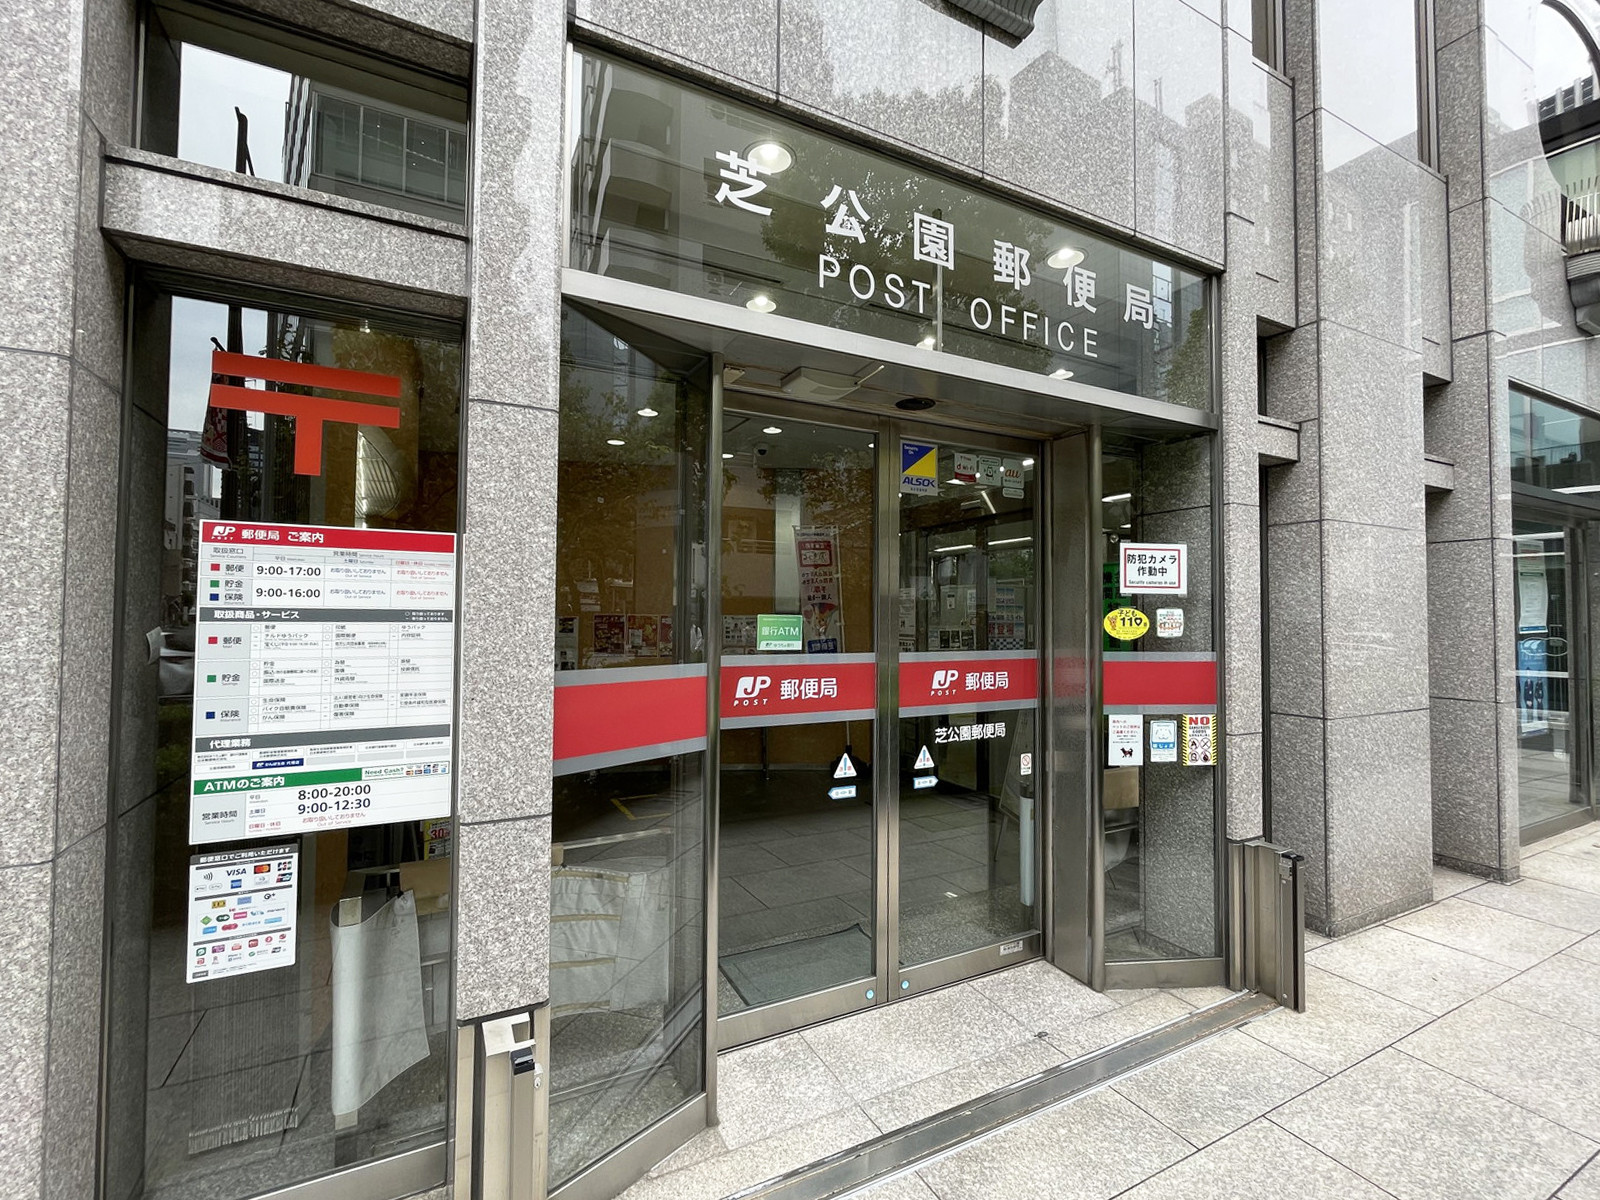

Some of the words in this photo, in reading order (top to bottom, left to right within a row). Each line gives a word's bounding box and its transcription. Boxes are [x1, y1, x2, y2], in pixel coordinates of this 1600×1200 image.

[714, 149, 1154, 329] 芝公園郵便局
[818, 254, 931, 314] POST
[970, 297, 1098, 358] OFFICE
[902, 476, 935, 487] ALSOK
[241, 529, 280, 541] 郵便局
[288, 531, 324, 543] ご案内
[1127, 554, 1177, 564] 防犯カメラ
[225, 564, 244, 573] 郵便
[256, 565, 321, 576] 9:00-17:00
[1137, 566, 1168, 577] 作動中
[224, 580, 243, 588] 貯金
[224, 593, 243, 601] 保険
[255, 588, 321, 598] 9:00-16:00
[214, 610, 300, 619] 取扱商品・サービス
[1118, 609, 1137, 617] 子ども
[761, 626, 799, 636] 銀行ATM
[223, 636, 242, 645] 郵便
[222, 674, 240, 682] 貯金
[931, 669, 959, 689] JP
[965, 671, 1009, 690] 郵便局
[735, 676, 771, 698] JP
[780, 678, 838, 700] 郵便局
[733, 699, 768, 707] POST
[220, 710, 240, 718] 保険
[1188, 716, 1210, 725] NO
[934, 722, 1006, 744] 芝公園郵便局
[210, 738, 251, 749] 代理業務
[203, 776, 285, 791] ATMのご案内
[298, 784, 371, 800] 8:00-20:00
[298, 798, 371, 815] 9:00-12:30
[202, 810, 237, 820] 営業時間
[226, 868, 247, 876] VISA
